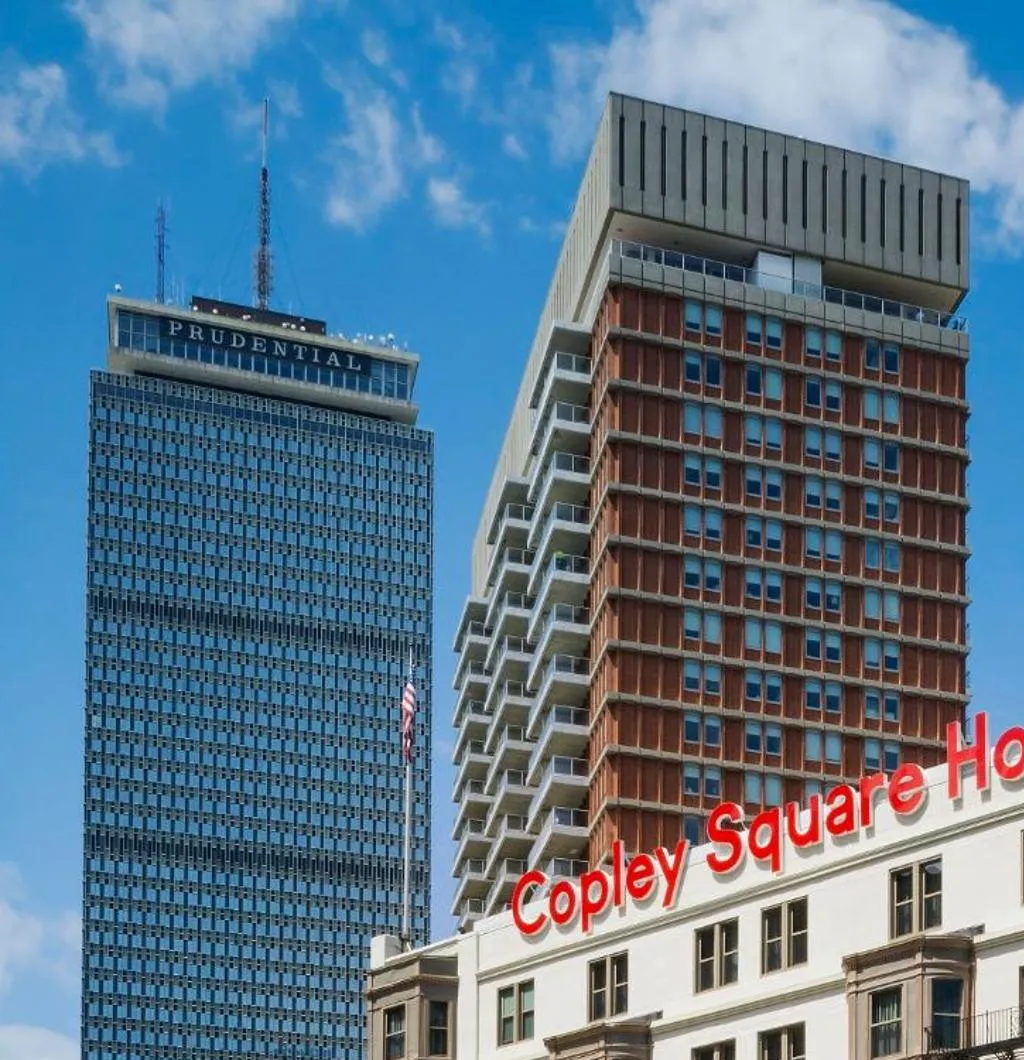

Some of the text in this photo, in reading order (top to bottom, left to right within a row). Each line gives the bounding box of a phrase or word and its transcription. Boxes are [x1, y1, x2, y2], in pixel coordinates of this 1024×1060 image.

[168, 320, 362, 371] PRUDENTIAL
[512, 838, 690, 936] Copley
[706, 761, 926, 875] Square
